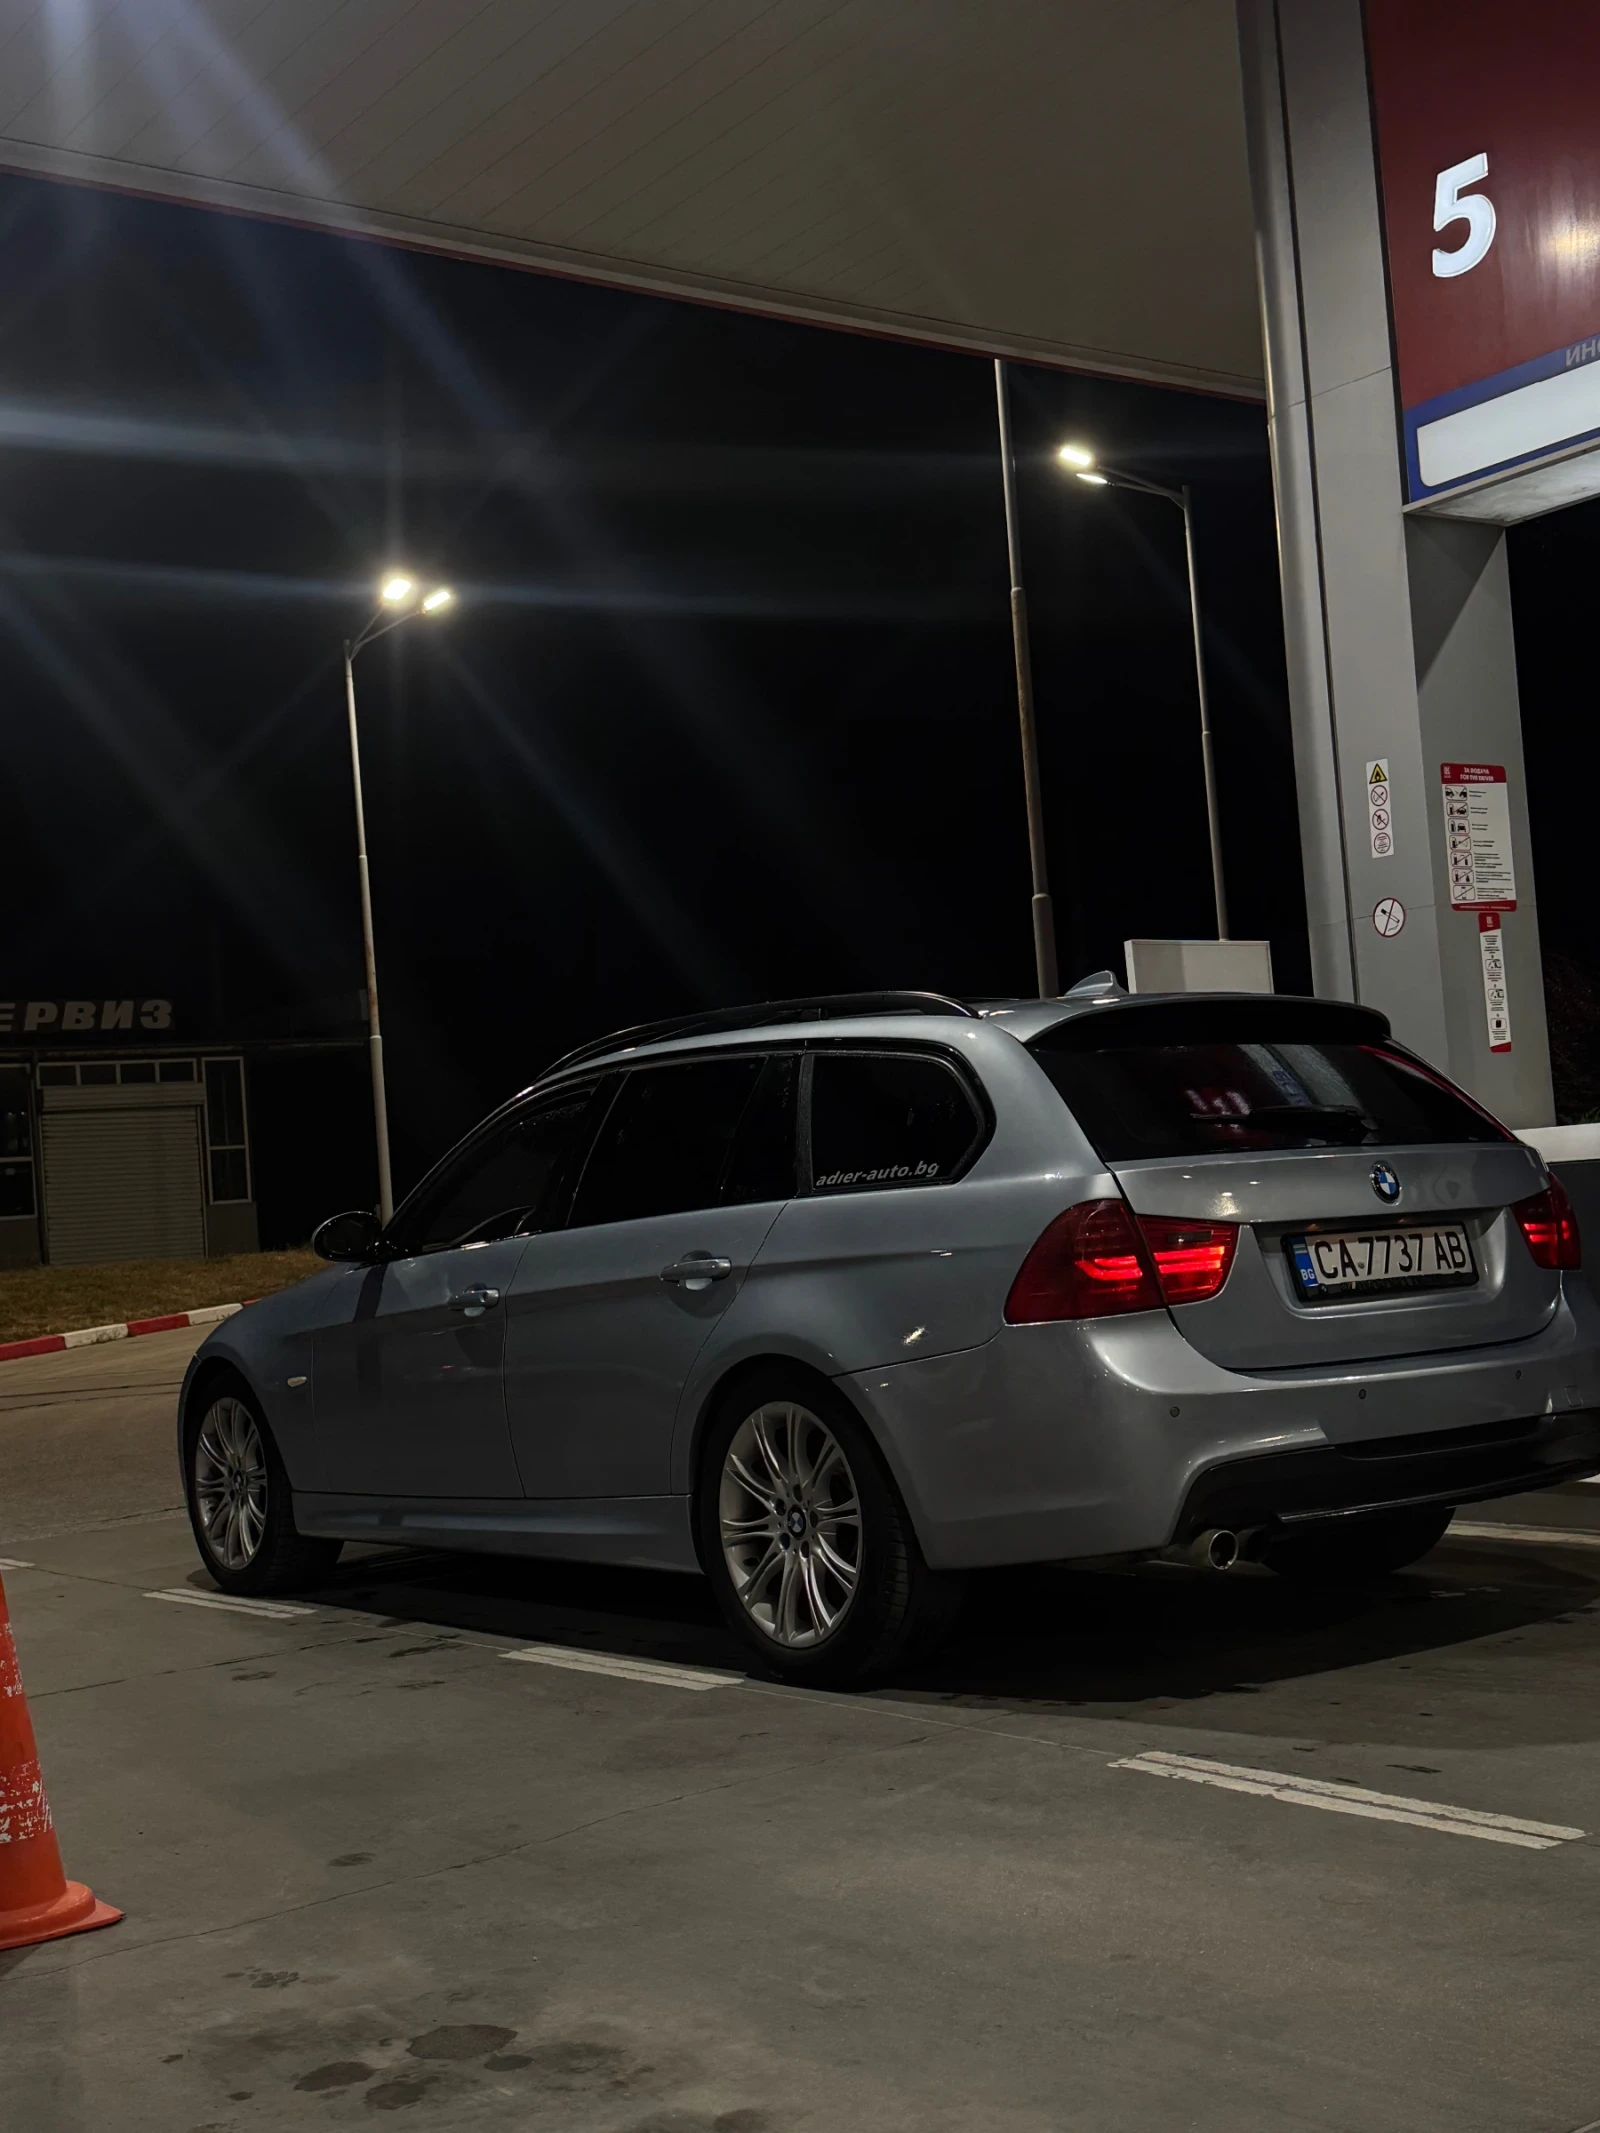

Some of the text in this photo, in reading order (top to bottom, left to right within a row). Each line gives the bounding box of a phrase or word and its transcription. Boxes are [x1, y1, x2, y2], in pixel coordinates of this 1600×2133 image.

[1432, 152, 1497, 279] 5
[1300, 1268, 1316, 1281] BG
[1358, 1233, 1423, 1276] 7737
